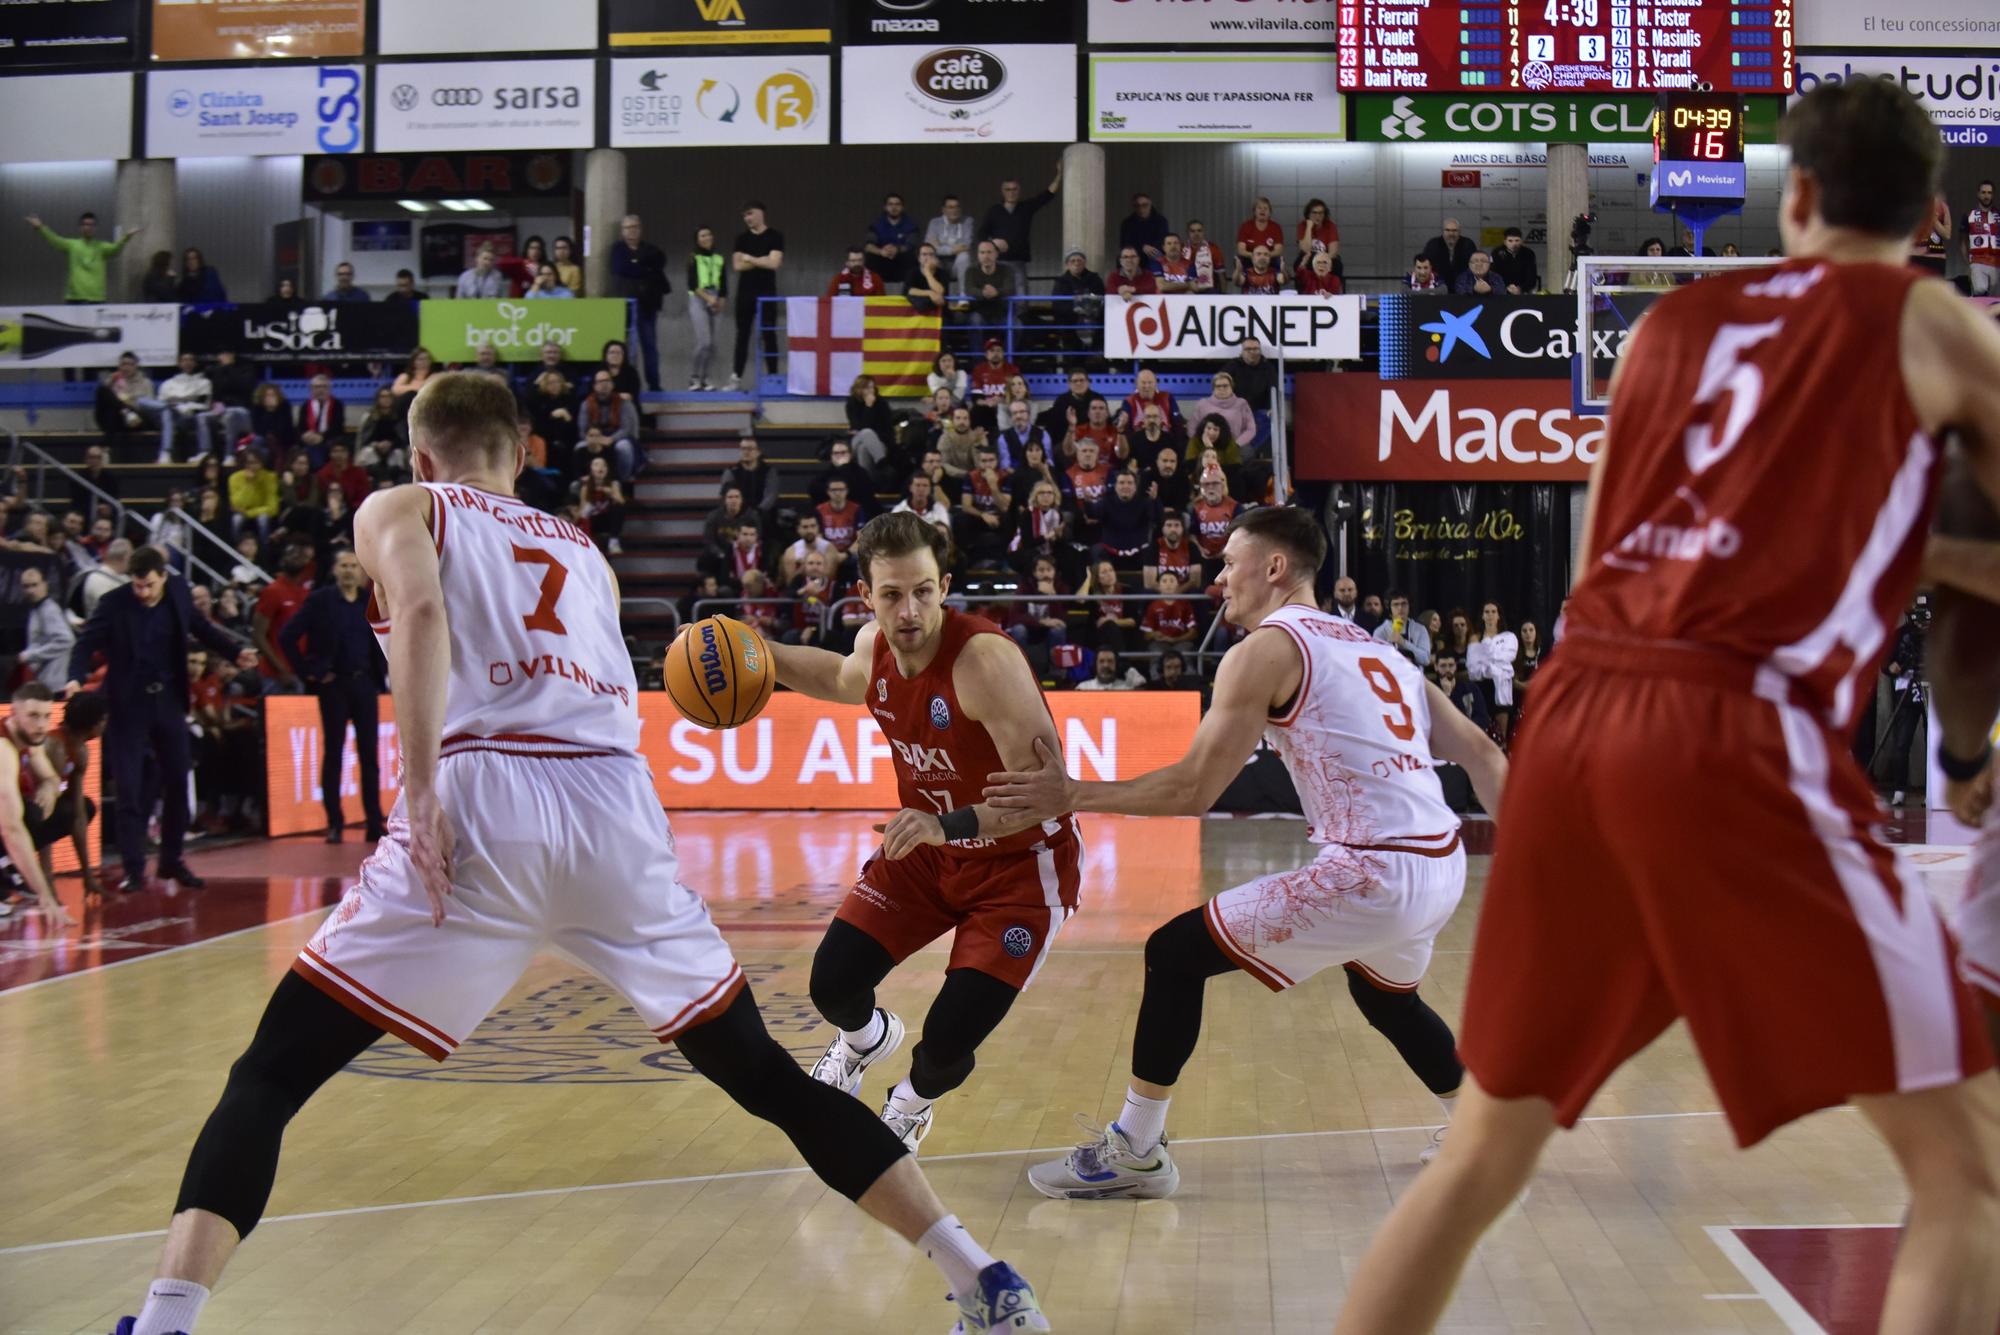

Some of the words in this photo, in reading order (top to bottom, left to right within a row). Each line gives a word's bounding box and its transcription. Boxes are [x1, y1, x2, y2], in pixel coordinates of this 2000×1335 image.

[1341, 9, 1355, 25] 17
[1364, 9, 1376, 26] F.
[1378, 8, 1419, 26] Ferrari
[1507, 9, 1519, 26] 11
[1544, 0, 1599, 27] 4:39
[1615, 9, 1628, 25] 17
[1637, 9, 1652, 27] M.
[1654, 8, 1691, 27] Foster
[1774, 9, 1791, 28] 22
[871, 18, 940, 33] mazda
[1210, 18, 1335, 31] www.vilavila.com
[1864, 17, 1875, 31] El
[1881, 18, 1904, 31] teu
[1339, 28, 1357, 46] 22
[1364, 28, 1374, 46] J.
[1376, 28, 1415, 46] Vaulet
[1510, 28, 1519, 46] 2
[1615, 29, 1629, 46] 21
[1637, 29, 1650, 47] G.
[1652, 29, 1701, 47] Masiulis
[1782, 29, 1792, 48] 0
[1339, 48, 1357, 67] 23
[1364, 48, 1379, 66] M.
[1382, 48, 1419, 67] Geben
[1510, 48, 1519, 66] 4
[1537, 37, 1546, 58] 2
[1588, 37, 1597, 59] 3
[934, 54, 983, 74] café
[1553, 64, 1606, 72] BASKETBALL
[1615, 49, 1629, 66] 25
[1637, 49, 1650, 67] B.
[1652, 49, 1691, 68] Varadi
[1782, 50, 1792, 69] 2
[929, 74, 988, 90] crem
[1339, 68, 1357, 87] 55
[1364, 68, 1392, 87] Dani
[1393, 67, 1428, 87] Pérez
[1510, 68, 1519, 87] 2
[1553, 72, 1612, 81] CHAMPIONS
[1615, 69, 1629, 87] 27
[1637, 69, 1650, 88] A.
[1652, 69, 1699, 88] Simonis
[1783, 70, 1793, 89] 0
[493, 86, 580, 110] sarsa
[622, 95, 682, 111] OSTEO
[1115, 92, 1183, 101] EXPLICA'NS
[1186, 92, 1210, 102] QUE
[1214, 92, 1290, 101] T'APASSIONA
[1294, 92, 1314, 101] FER
[200, 111, 241, 127] Sant
[247, 110, 299, 128] Josep
[317, 66, 362, 154] CSJ
[622, 111, 681, 127] SPORT
[1444, 102, 1557, 132] COTS
[1569, 103, 1577, 132] i
[1673, 107, 1732, 129] 04:39
[1693, 130, 1724, 159] 16
[1452, 154, 1488, 164] AMICS
[1490, 154, 1512, 164] DEL
[359, 156, 511, 192] BAR
[1697, 175, 1737, 185] Movistar
[264, 322, 343, 350] Soca
[466, 321, 520, 347] brot
[526, 322, 578, 346] d'or
[1177, 304, 1339, 348] AIGNEP
[1684, 316, 1787, 476] 5
[1378, 389, 1609, 464] Macsa
[1393, 508, 1471, 541] Bruixa
[508, 538, 569, 637] 7
[700, 623, 729, 697] Wilson
[517, 654, 630, 707] VILNIUS
[1358, 656, 1416, 742] 9
[668, 718, 774, 785] SU
[891, 737, 956, 772] BAXI
